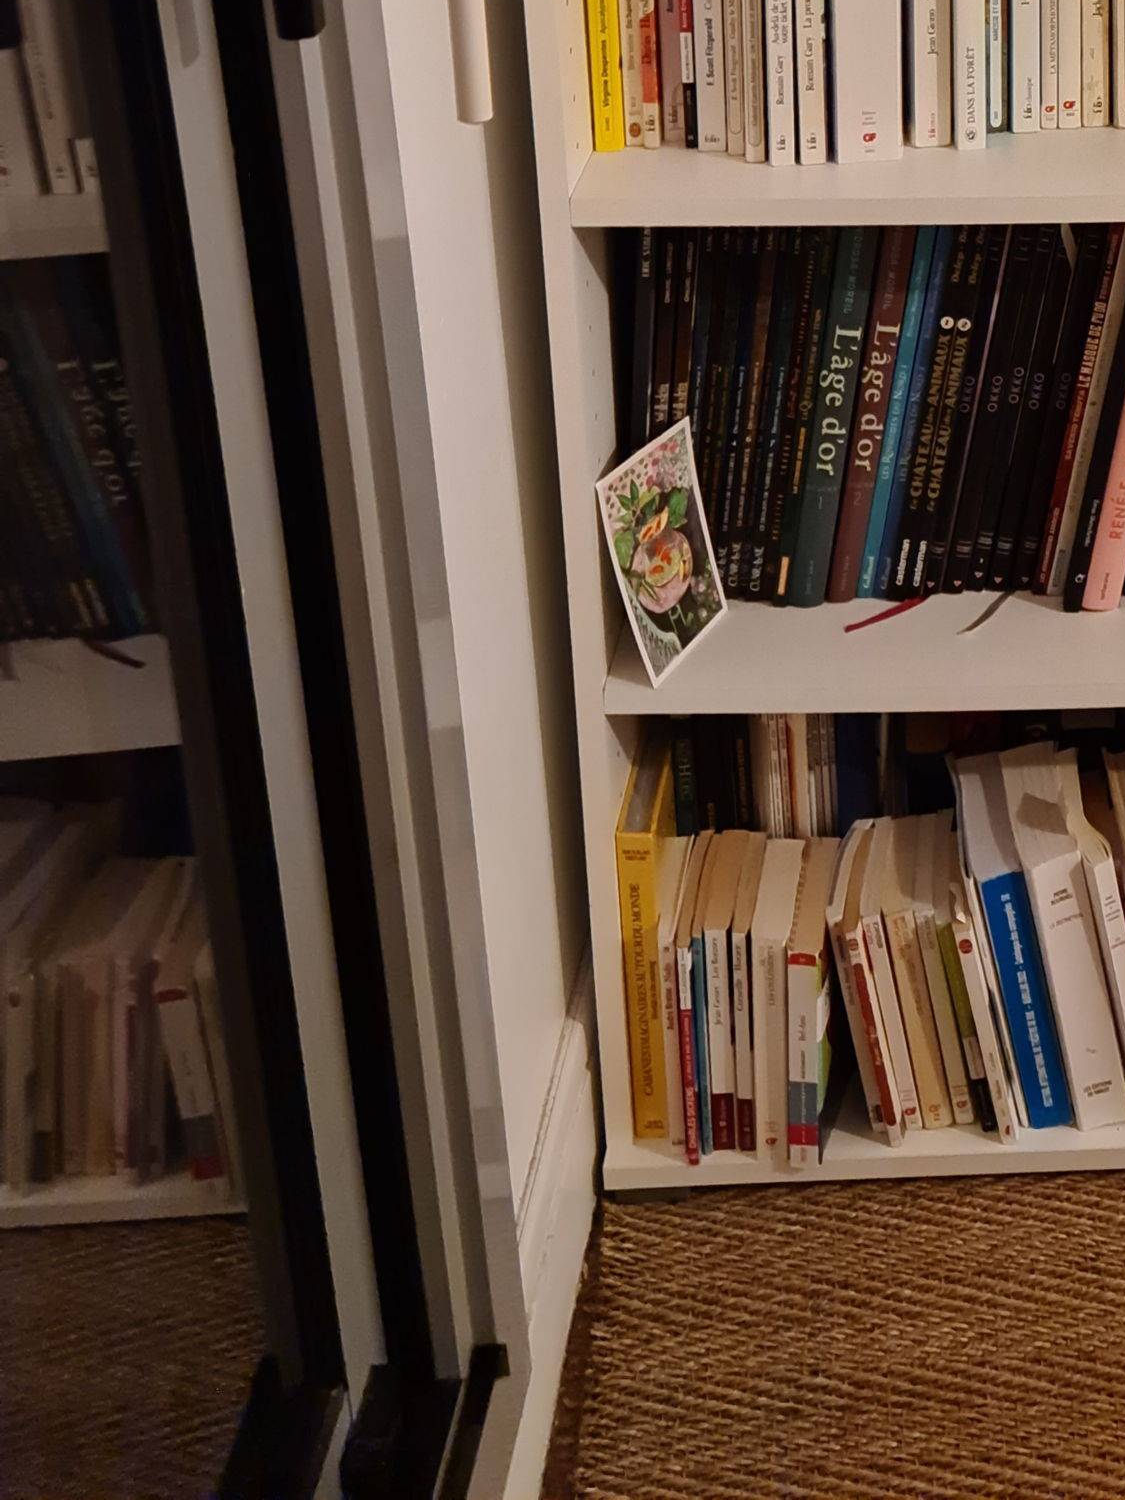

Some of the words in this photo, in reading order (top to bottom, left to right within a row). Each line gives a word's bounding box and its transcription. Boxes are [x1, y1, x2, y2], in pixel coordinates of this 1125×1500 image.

[964, 46, 975, 80] FORÊT
[967, 81, 975, 96] LA
[967, 98, 976, 124] DANS
[987, 375, 1004, 412] OKKO
[1008, 367, 1025, 404] OKKO
[1028, 373, 1045, 410] OKKO
[894, 538, 911, 586] casterman
[911, 540, 927, 587] casterman
